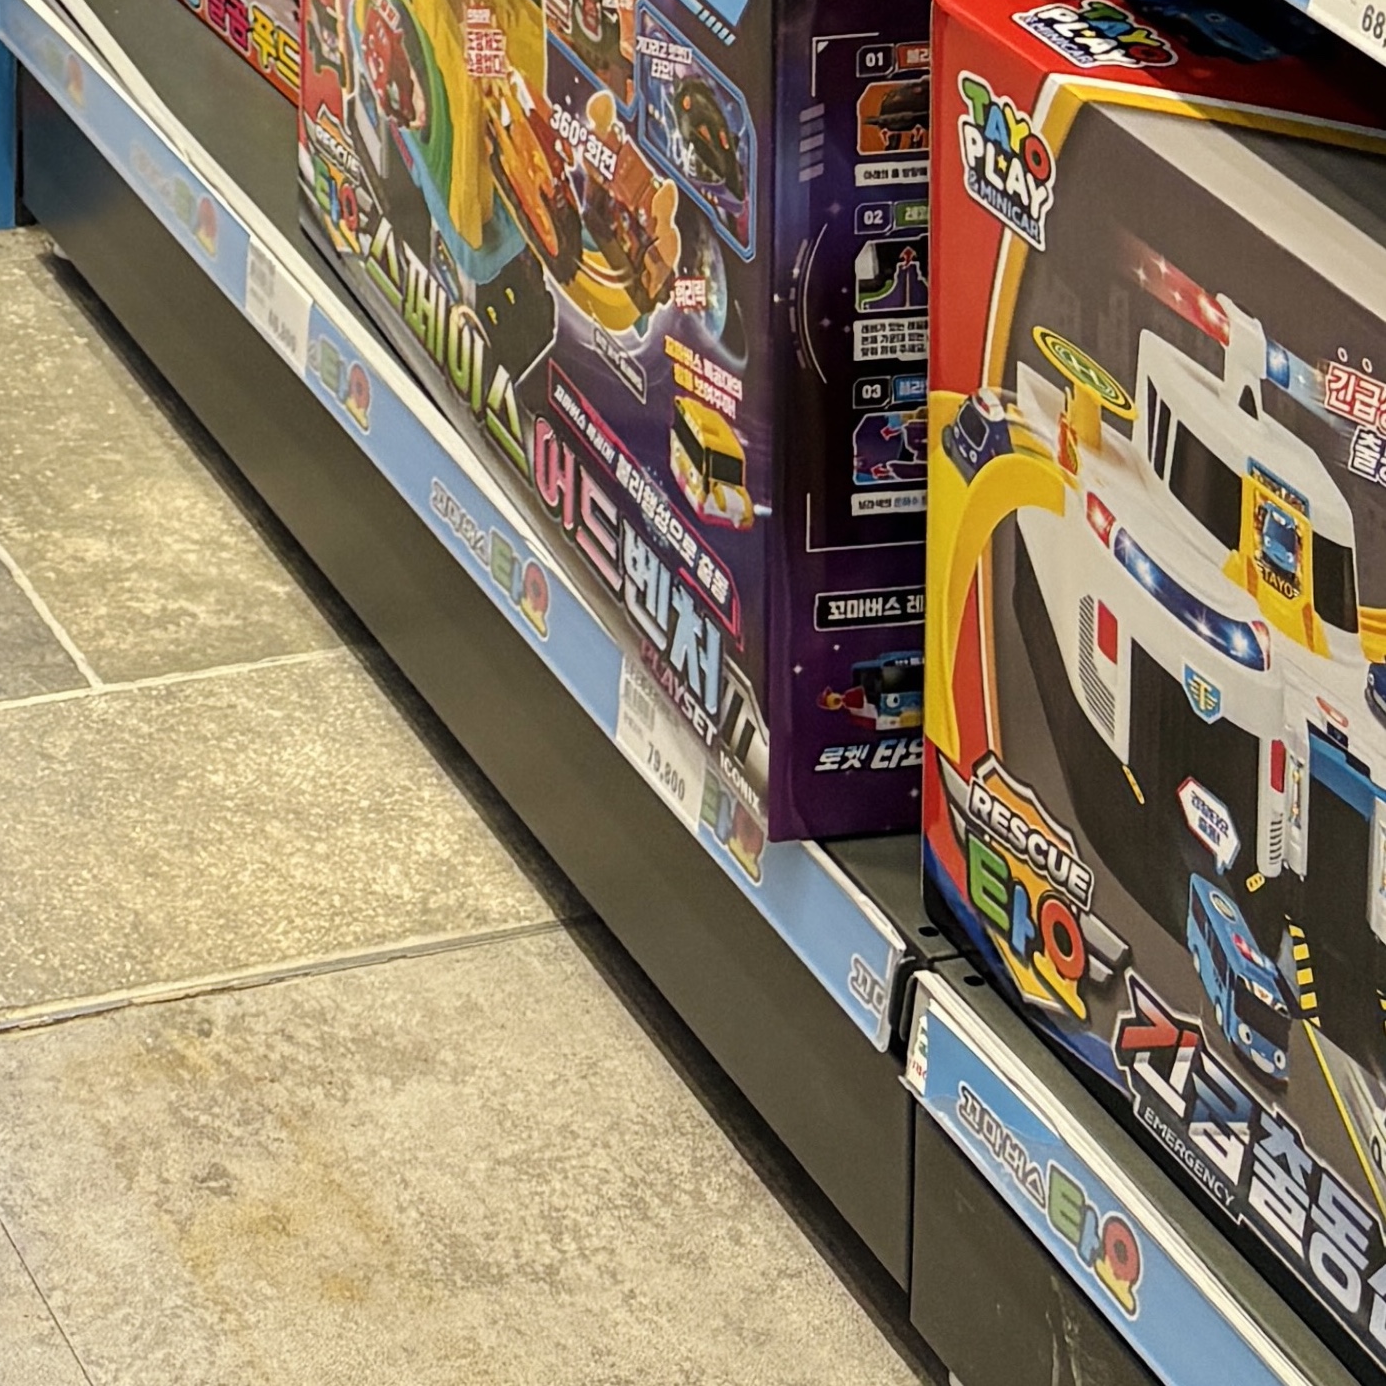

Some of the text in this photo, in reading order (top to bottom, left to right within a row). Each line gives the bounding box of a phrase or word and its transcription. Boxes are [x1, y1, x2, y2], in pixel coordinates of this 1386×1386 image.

[865, 51, 886, 70] 01
[1038, 4, 1138, 67] PLAY
[961, 76, 1053, 182] TAYO
[963, 133, 1052, 220] PLAY
[862, 209, 884, 225] 02
[979, 182, 1043, 244] MINICAR
[365, 215, 530, 481] 스페이스
[861, 382, 883, 401] 03
[490, 528, 552, 641] 타요
[827, 596, 902, 620] 꼬마버스
[1258, 562, 1302, 600] TAYO
[646, 739, 686, 802] 79,800
[717, 748, 762, 815] ICONIX
[815, 741, 869, 774] 로켓
[972, 780, 1093, 906] RESCUE
[966, 834, 1089, 1021] 타요
[1143, 1104, 1236, 1209] EMERGENCY
[958, 1081, 1143, 1320] 꼬마버스 타요
